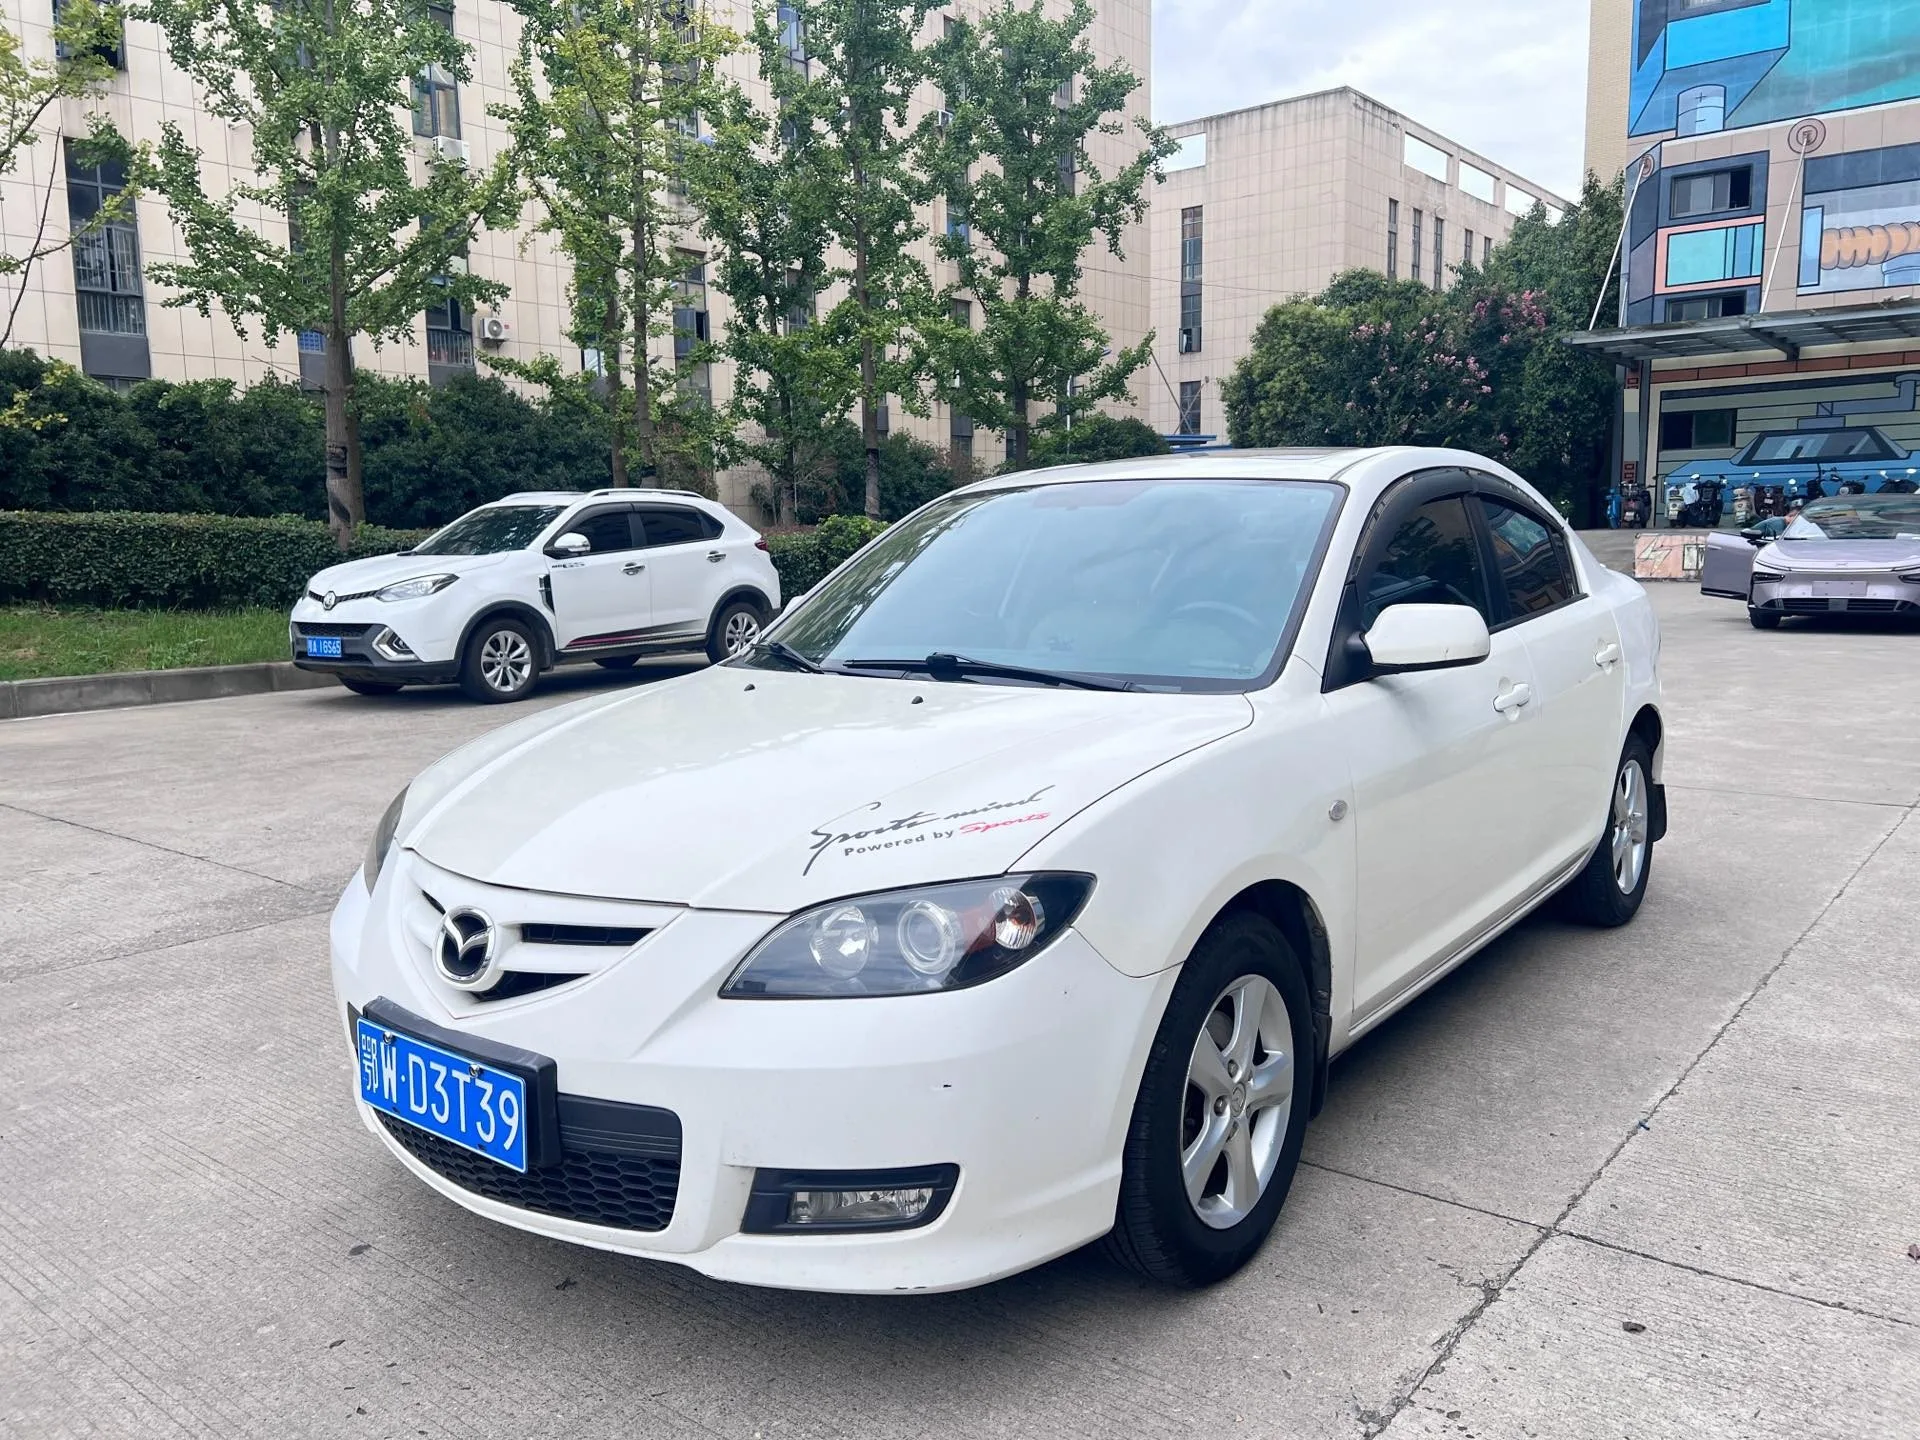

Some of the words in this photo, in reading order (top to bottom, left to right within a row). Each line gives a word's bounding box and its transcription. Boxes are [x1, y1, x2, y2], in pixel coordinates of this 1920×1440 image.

[943, 784, 1056, 820] mind
[844, 834, 925, 857] Powered
[933, 829, 954, 840] by
[960, 811, 1051, 833] Sports
